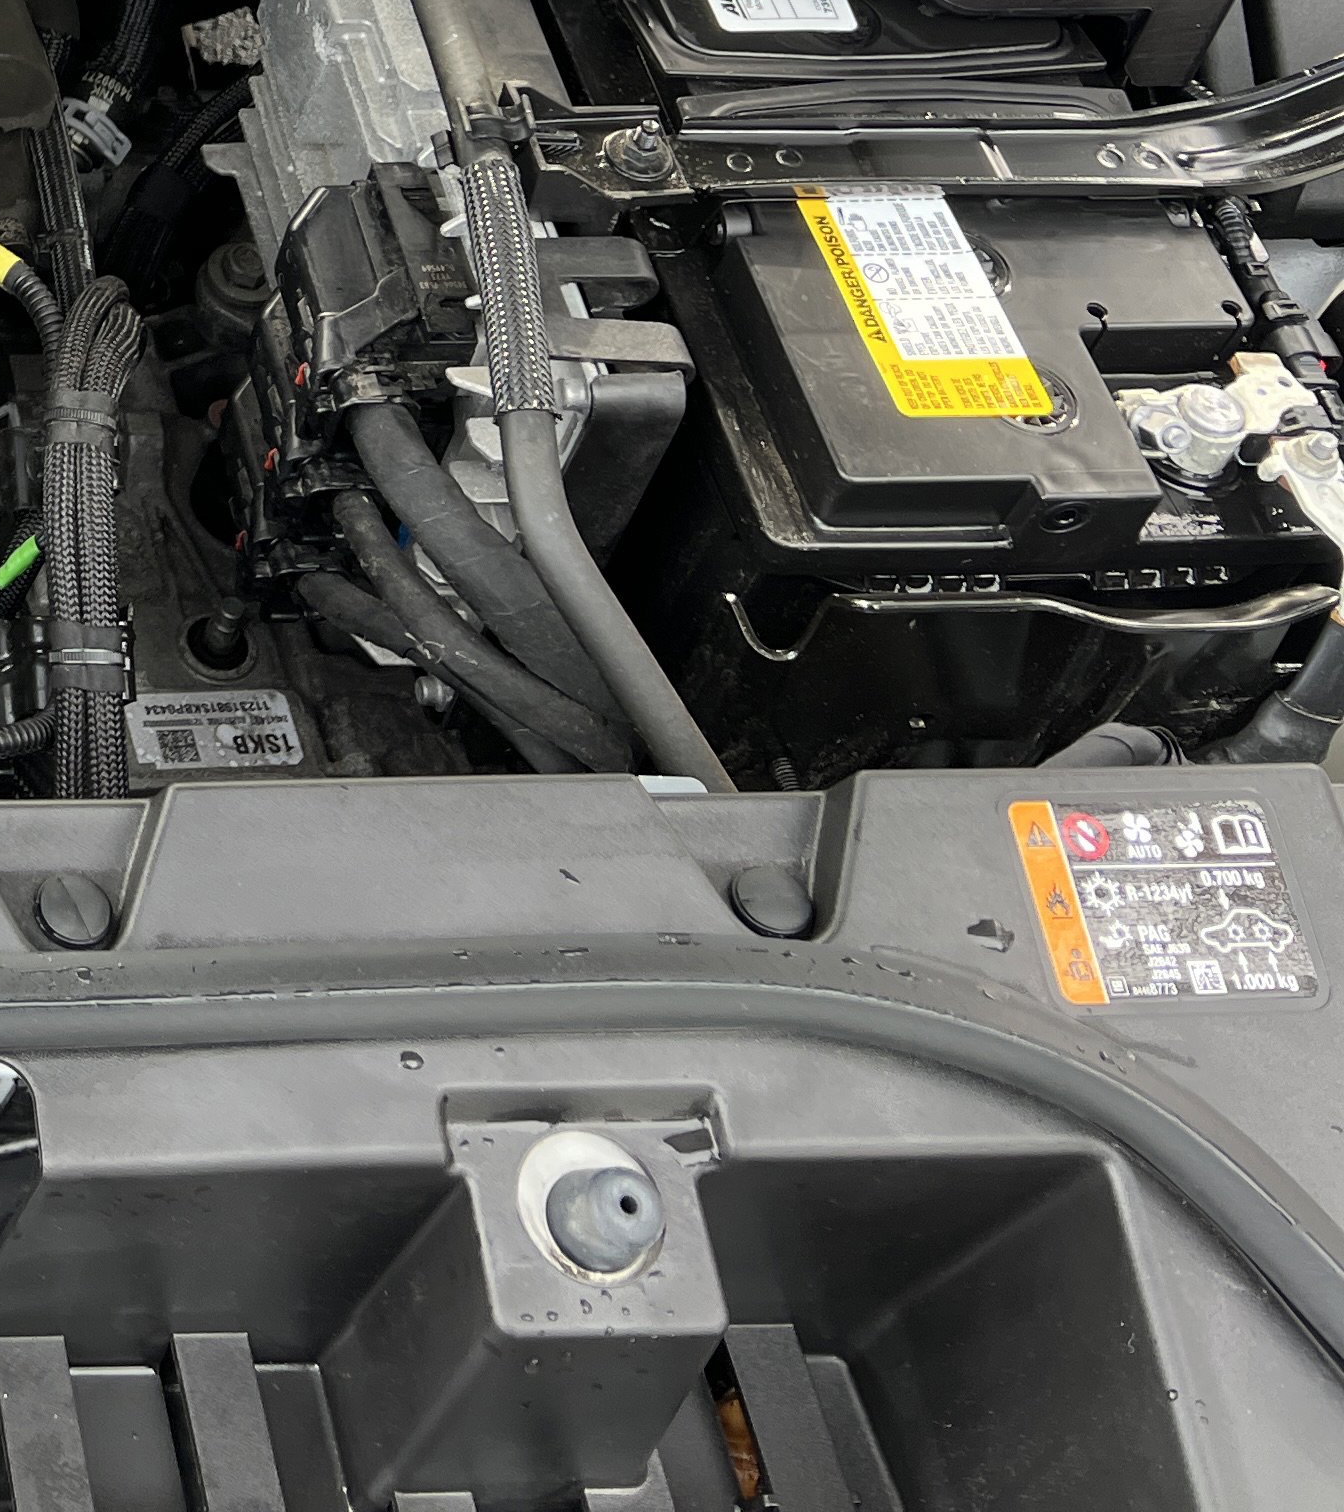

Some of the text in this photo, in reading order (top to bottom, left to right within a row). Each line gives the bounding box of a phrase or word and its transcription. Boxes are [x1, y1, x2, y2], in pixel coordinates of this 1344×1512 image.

[232, 733, 295, 754] 1SKB
[1127, 845, 1162, 859] AUTO
[1200, 869, 1266, 889] 0.700 kg
[1137, 924, 1171, 942] PAG
[1231, 973, 1299, 993] 1.000 kg
